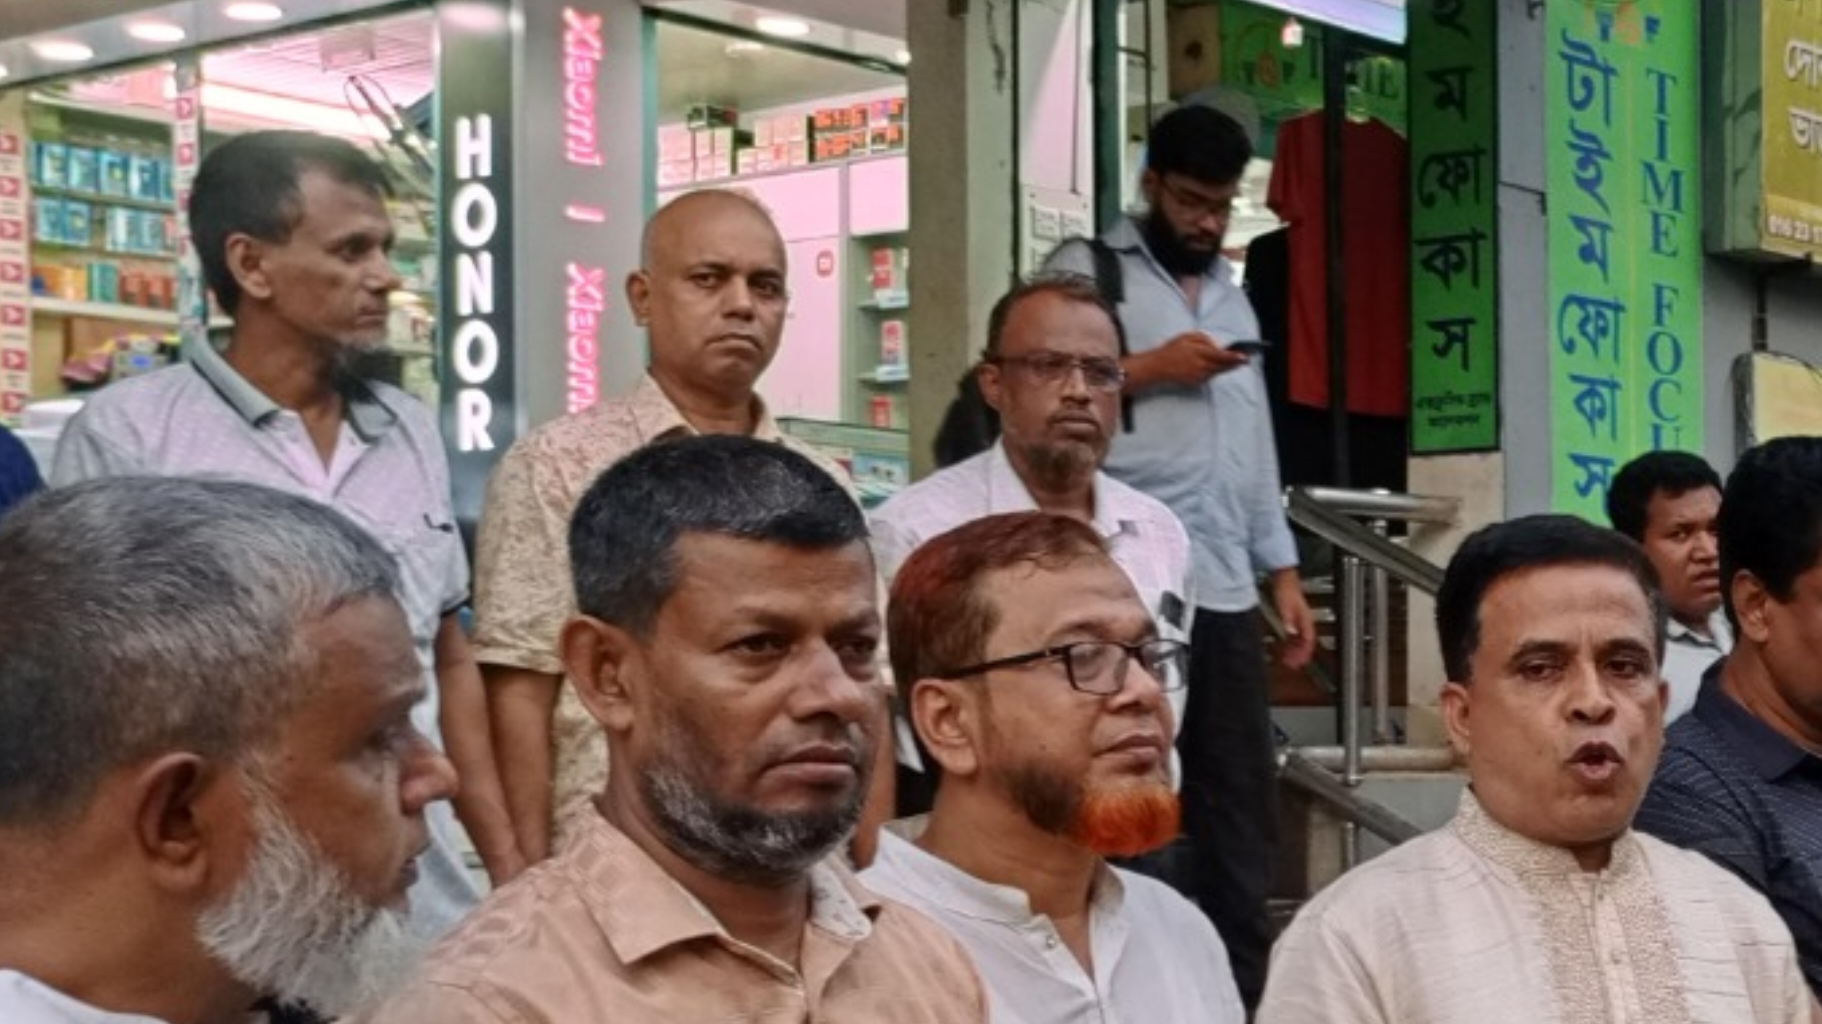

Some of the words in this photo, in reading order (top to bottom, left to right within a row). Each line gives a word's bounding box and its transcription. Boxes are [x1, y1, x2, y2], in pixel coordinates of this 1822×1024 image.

[1640, 66, 1686, 259] TIME
[450, 112, 500, 453] HONOR
[1644, 283, 1685, 452] FOCU
